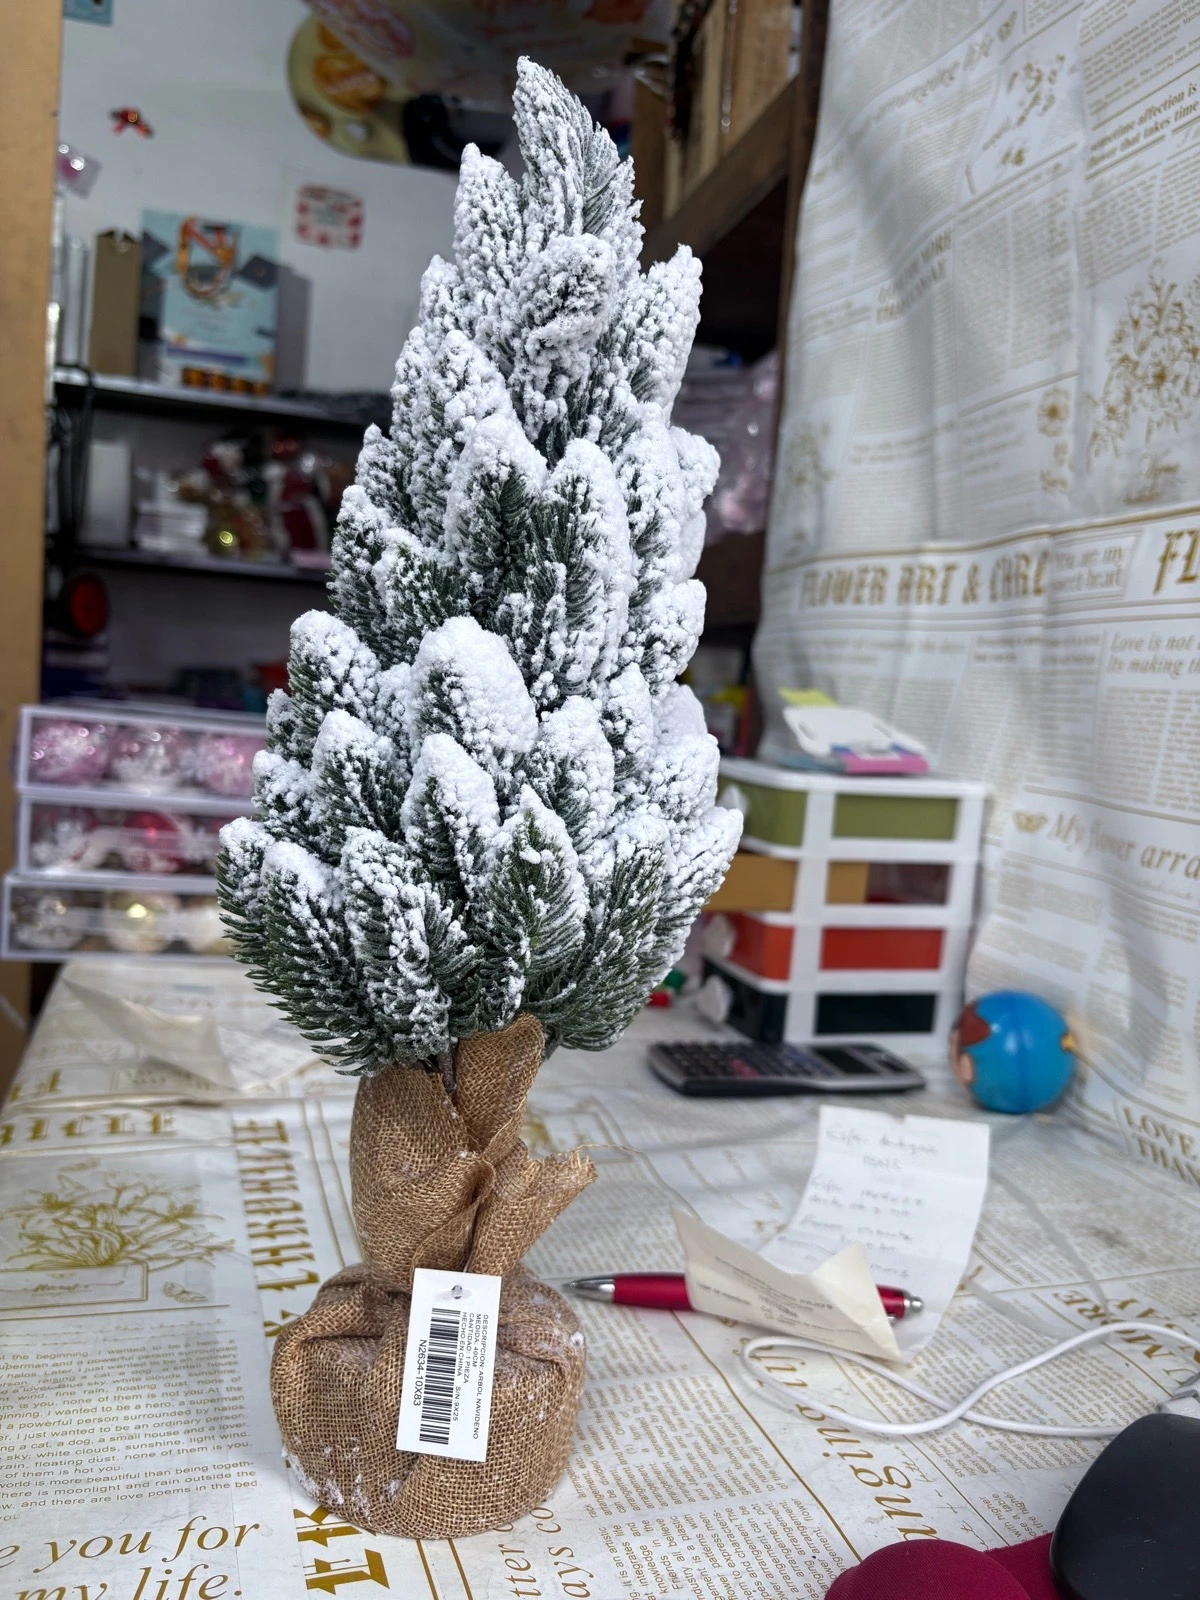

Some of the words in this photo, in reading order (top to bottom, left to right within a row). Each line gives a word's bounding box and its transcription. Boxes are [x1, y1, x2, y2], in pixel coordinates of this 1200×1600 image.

[1138, 91, 1185, 126] affection
[1187, 83, 1197, 97] is
[1144, 117, 1171, 138] takes
[1175, 101, 1199, 121] time
[897, 563, 958, 606] ART
[961, 562, 980, 606] &
[1110, 632, 1146, 652] Love
[1148, 632, 1163, 652] is
[1166, 632, 1195, 652] not
[1128, 653, 1185, 679] making
[1122, 1105, 1198, 1162] LOVE
[466, 1313, 474, 1354] CANTIDAD:
[473, 1313, 481, 1345] MEDIDA:
[479, 1315, 488, 1369] DESCRIPCION:
[459, 1341, 465, 1350] EN
[413, 1339, 427, 1406] N2634-10X83
[24, 1429, 46, 1441] just
[51, 1424, 95, 1436] wanted
[100, 1423, 111, 1431] to
[115, 1422, 129, 1430] be
[153, 1416, 201, 1426] ordinary
[205, 1412, 245, 1424] person
[109, 1431, 140, 1441] small
[144, 1429, 180, 1438] house
[183, 1425, 205, 1434] and
[35, 1456, 83, 1467] floating
[125, 1450, 156, 1459] none
[161, 1447, 172, 1455] of
[177, 1445, 208, 1454] them
[213, 1442, 222, 1450] is
[37, 1447, 70, 1458] white
[190, 1433, 215, 1444] light
[5, 1470, 17, 1479] of
[23, 1469, 54, 1477] them
[59, 1467, 69, 1475] is
[74, 1465, 93, 1474] not
[35, 1478, 45, 1486] is
[50, 1476, 82, 1484] more
[87, 1469, 140, 1481] beautiful
[144, 1467, 171, 1476] than
[175, 1464, 208, 1473] being
[213, 1459, 254, 1471] togeth-
[38, 1487, 49, 1496] is
[54, 1480, 120, 1494] moonlight
[126, 1478, 150, 1487] and
[155, 1475, 180, 1485] rain
[184, 1471, 232, 1482] outside
[237, 1468, 256, 1477] the
[21, 1498, 46, 1508] and
[51, 1496, 85, 1505] there
[91, 1494, 111, 1502] are
[116, 1491, 143, 1499] love
[148, 1486, 191, 1498] poems
[196, 1484, 206, 1492] in
[211, 1481, 230, 1490] the
[992, 1494, 1012, 1512] table
[530, 1506, 563, 1535] co
[725, 1508, 738, 1522] The
[739, 1506, 749, 1515] be
[791, 1498, 812, 1521] flower
[980, 1496, 1005, 1520] higher
[613, 1525, 625, 1536] life
[626, 1522, 641, 1537] and
[642, 1520, 653, 1532] the
[656, 1518, 677, 1547] believe
[670, 1515, 691, 1541] plastic
[683, 1514, 698, 1529] with
[700, 1512, 714, 1531] men-
[714, 1510, 745, 1558] characteris-
[748, 1518, 761, 1533] can
[32, 1531, 152, 1573] you
[161, 1515, 260, 1562] for
[598, 1527, 617, 1553] artistic
[696, 1534, 720, 1568] patterns
[714, 1533, 735, 1567] express
[737, 1524, 774, 1578] arrangement
[613, 1556, 624, 1567] an
[622, 1542, 649, 1587] integrates
[640, 1545, 669, 1594] knowledge
[672, 1552, 685, 1561] all
[742, 1561, 758, 1578] and
[758, 1536, 799, 1592] arrangement
[547, 1546, 594, 1598] ays
[661, 1555, 683, 1590] Friends
[733, 1571, 742, 1579] to
